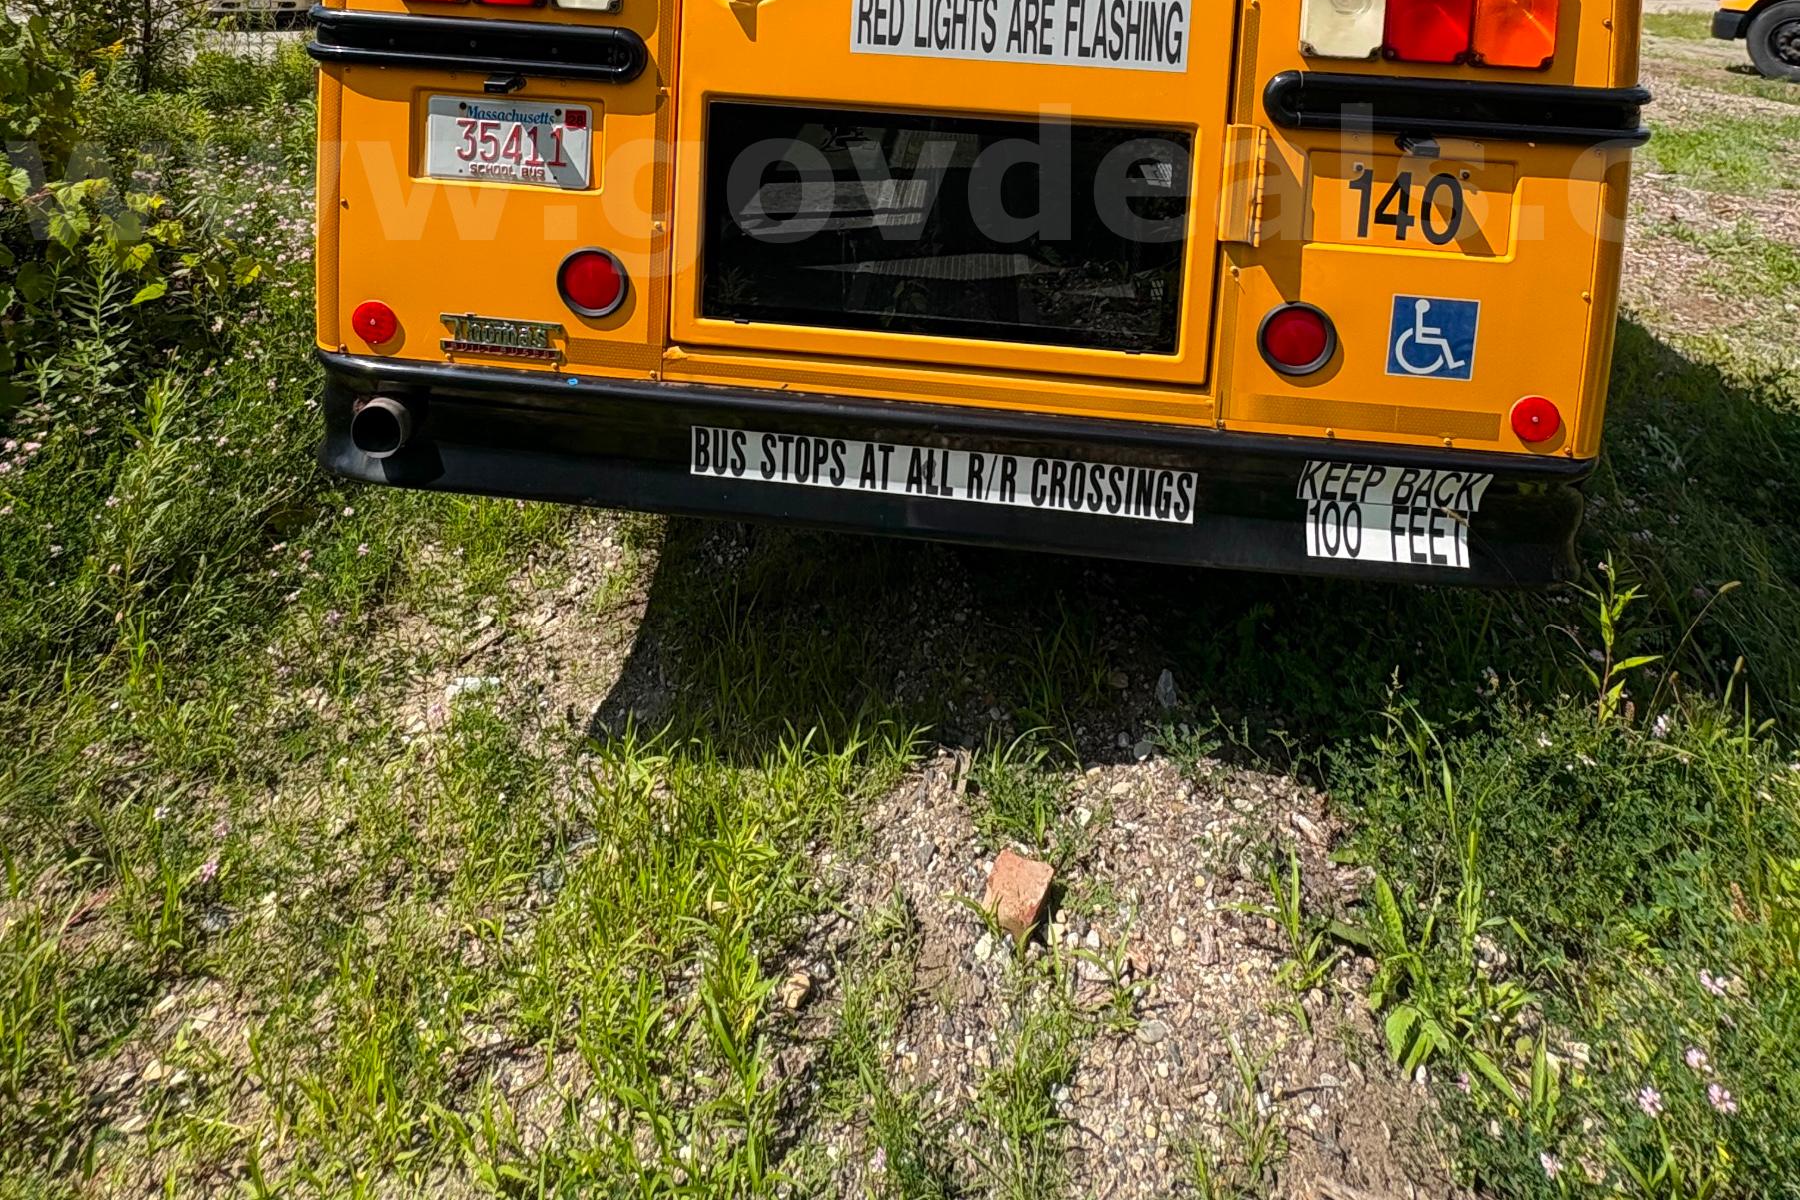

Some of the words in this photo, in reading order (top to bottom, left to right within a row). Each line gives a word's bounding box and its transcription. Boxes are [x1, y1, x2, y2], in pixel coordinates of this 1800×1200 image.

[466, 104, 555, 125] Massachusetts
[456, 119, 567, 167] 35411
[469, 162, 517, 178] SCHOOL
[521, 167, 546, 182] BUS
[1349, 168, 1465, 246] 140
[694, 427, 747, 476] BUS
[760, 433, 847, 487] STOPS
[859, 444, 895, 490] AT
[905, 448, 954, 497] ALL
[967, 452, 1017, 504] R/R
[1031, 461, 1194, 522] CROSSINGS
[1298, 461, 1386, 502] KEEP
[1393, 469, 1489, 511] BACK
[1308, 500, 1363, 558] 100
[1390, 506, 1468, 567] FEET
